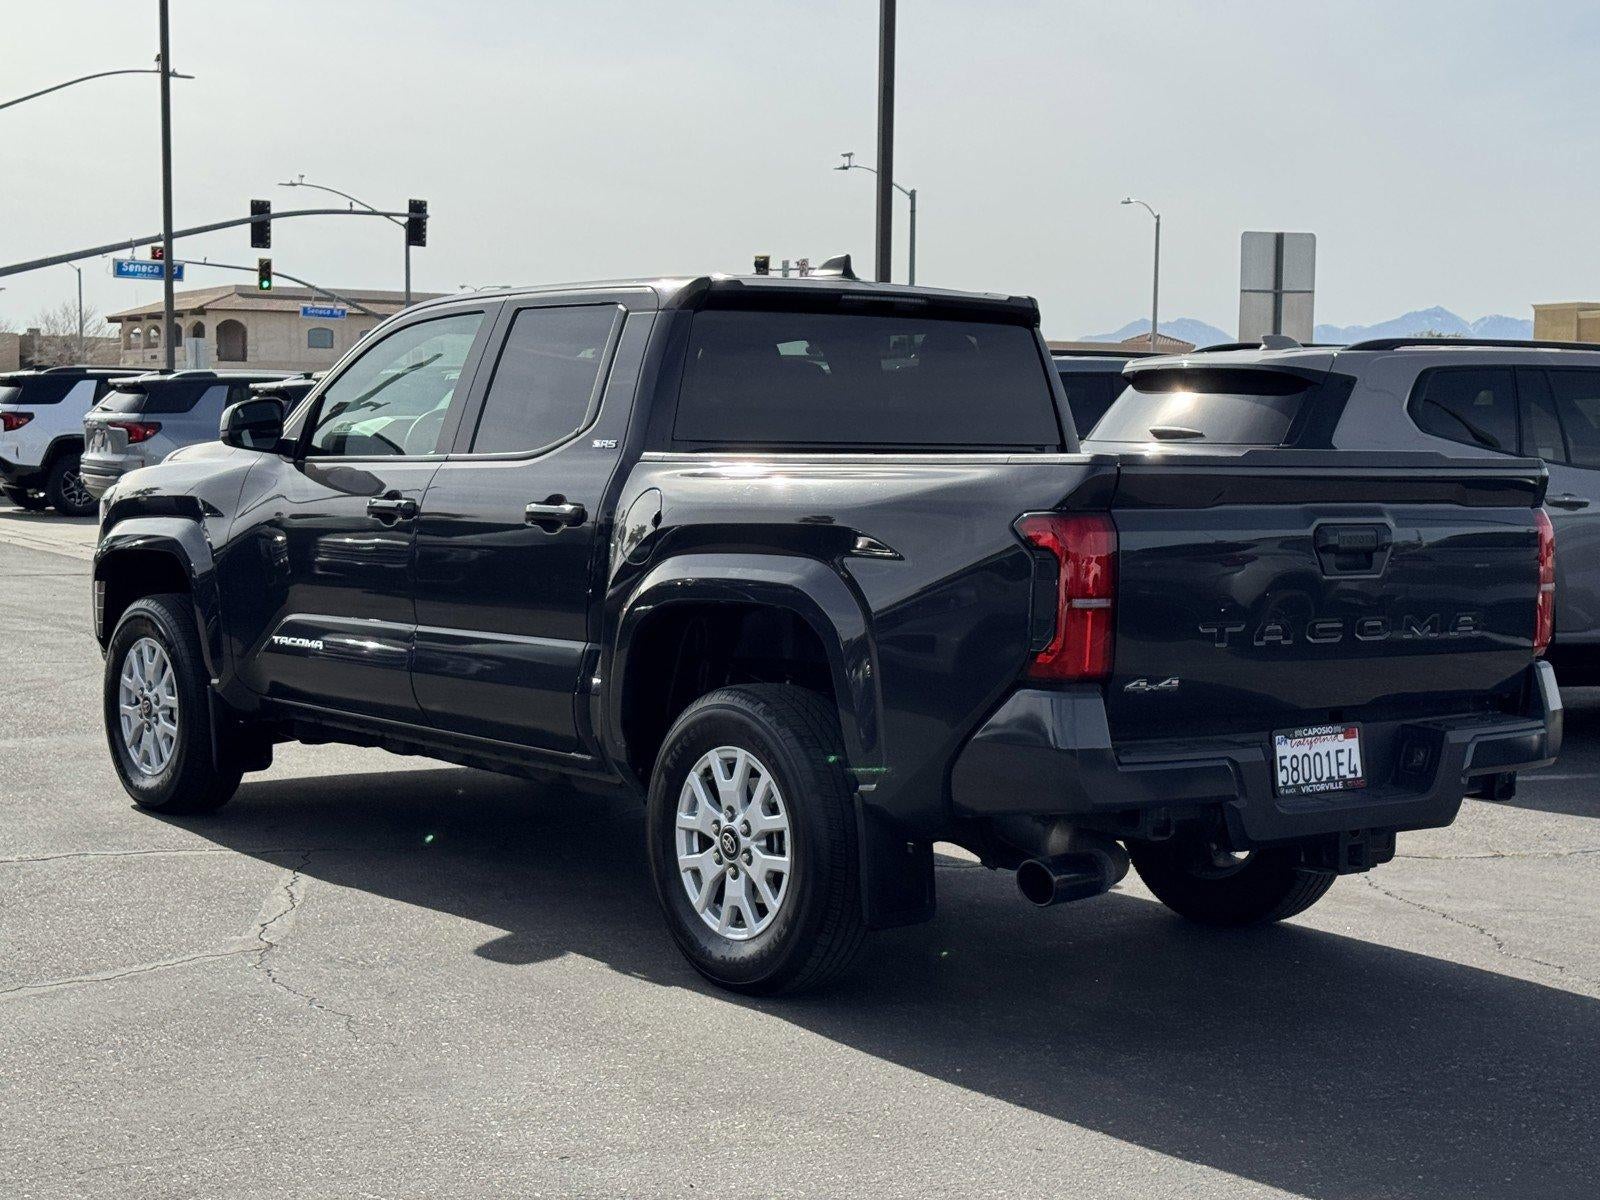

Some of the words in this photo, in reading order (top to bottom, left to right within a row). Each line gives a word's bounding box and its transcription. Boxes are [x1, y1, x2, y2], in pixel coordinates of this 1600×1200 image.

[121, 260, 160, 273] Seneca
[1199, 612, 1481, 647] TACOMA
[272, 635, 324, 649] TACOMA
[1303, 726, 1333, 736] CAPOSIO
[1279, 748, 1358, 785] 58001E4
[1301, 781, 1343, 793] VICTORVILLE
